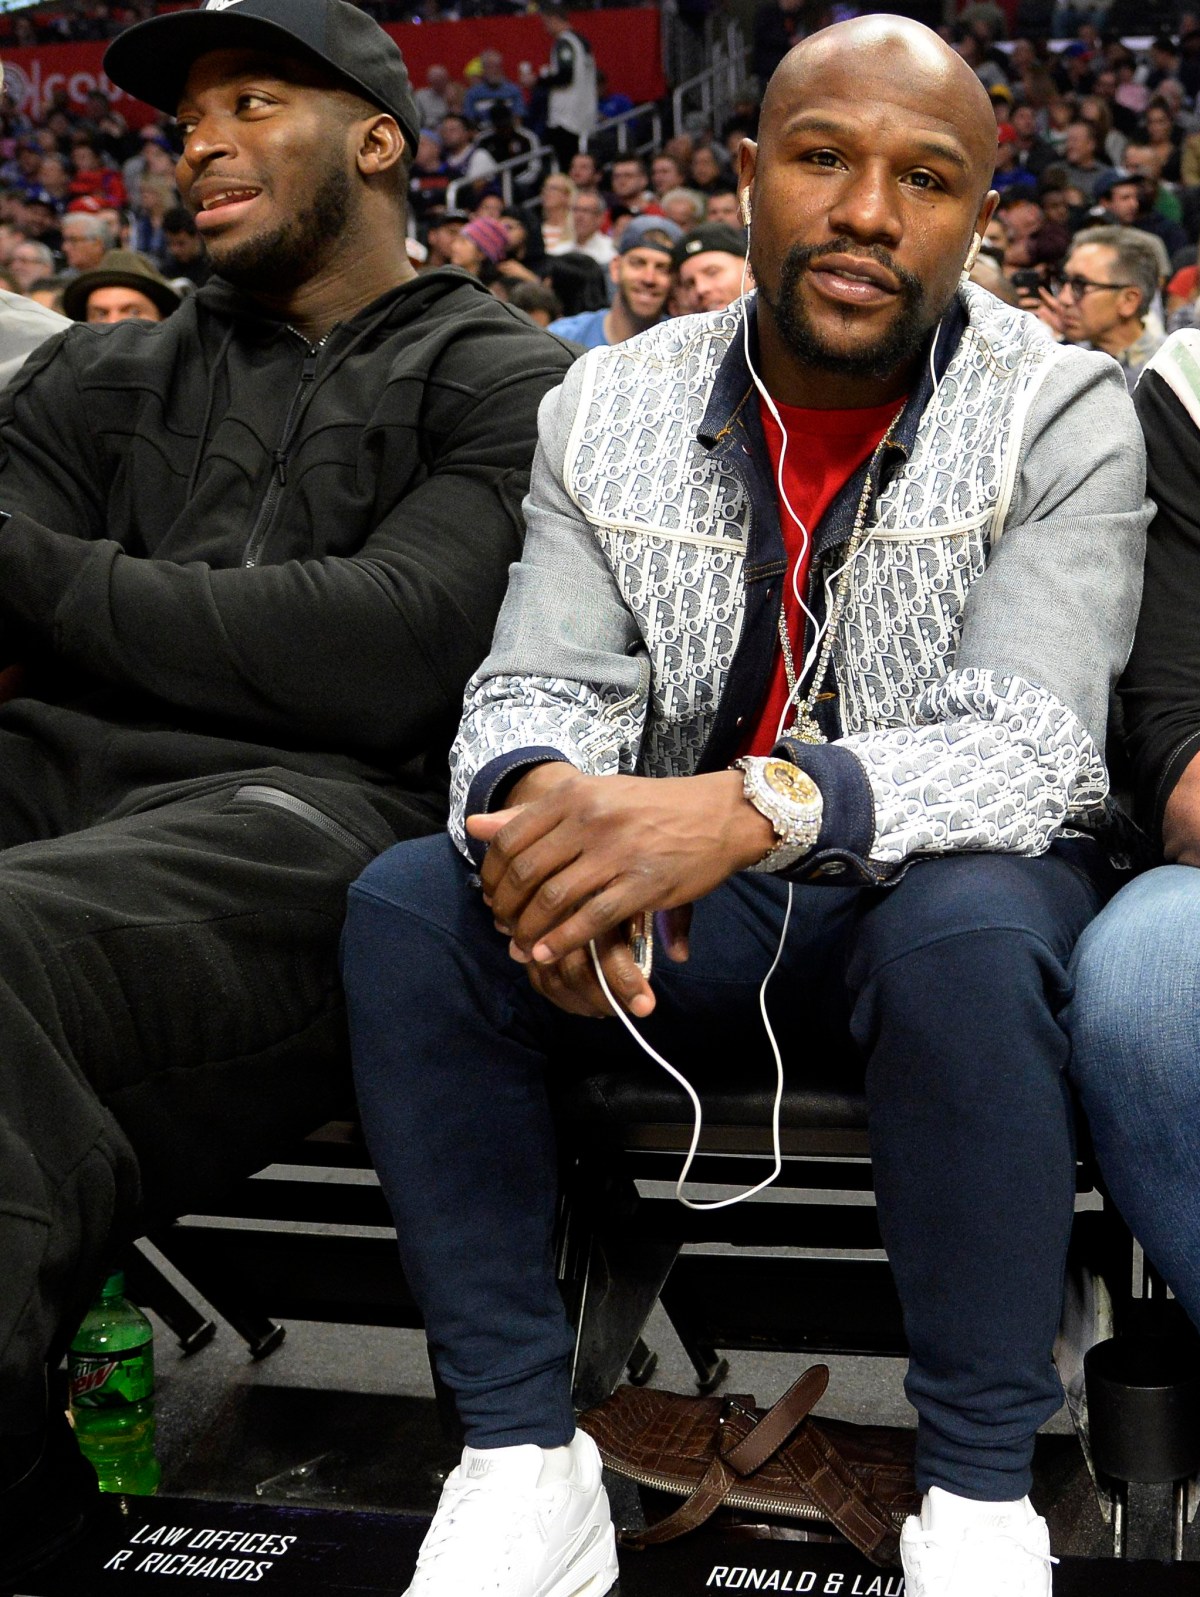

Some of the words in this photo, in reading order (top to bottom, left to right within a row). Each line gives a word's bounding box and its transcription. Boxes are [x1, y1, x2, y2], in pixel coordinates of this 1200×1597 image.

[130, 1524, 191, 1546] LAW
[187, 1529, 297, 1555] OFFICES
[104, 1550, 133, 1571] R.
[135, 1551, 273, 1582] RICHARDS
[706, 1565, 817, 1592] RONALD
[823, 1572, 844, 1594] &
[851, 1574, 906, 1597] LAU
